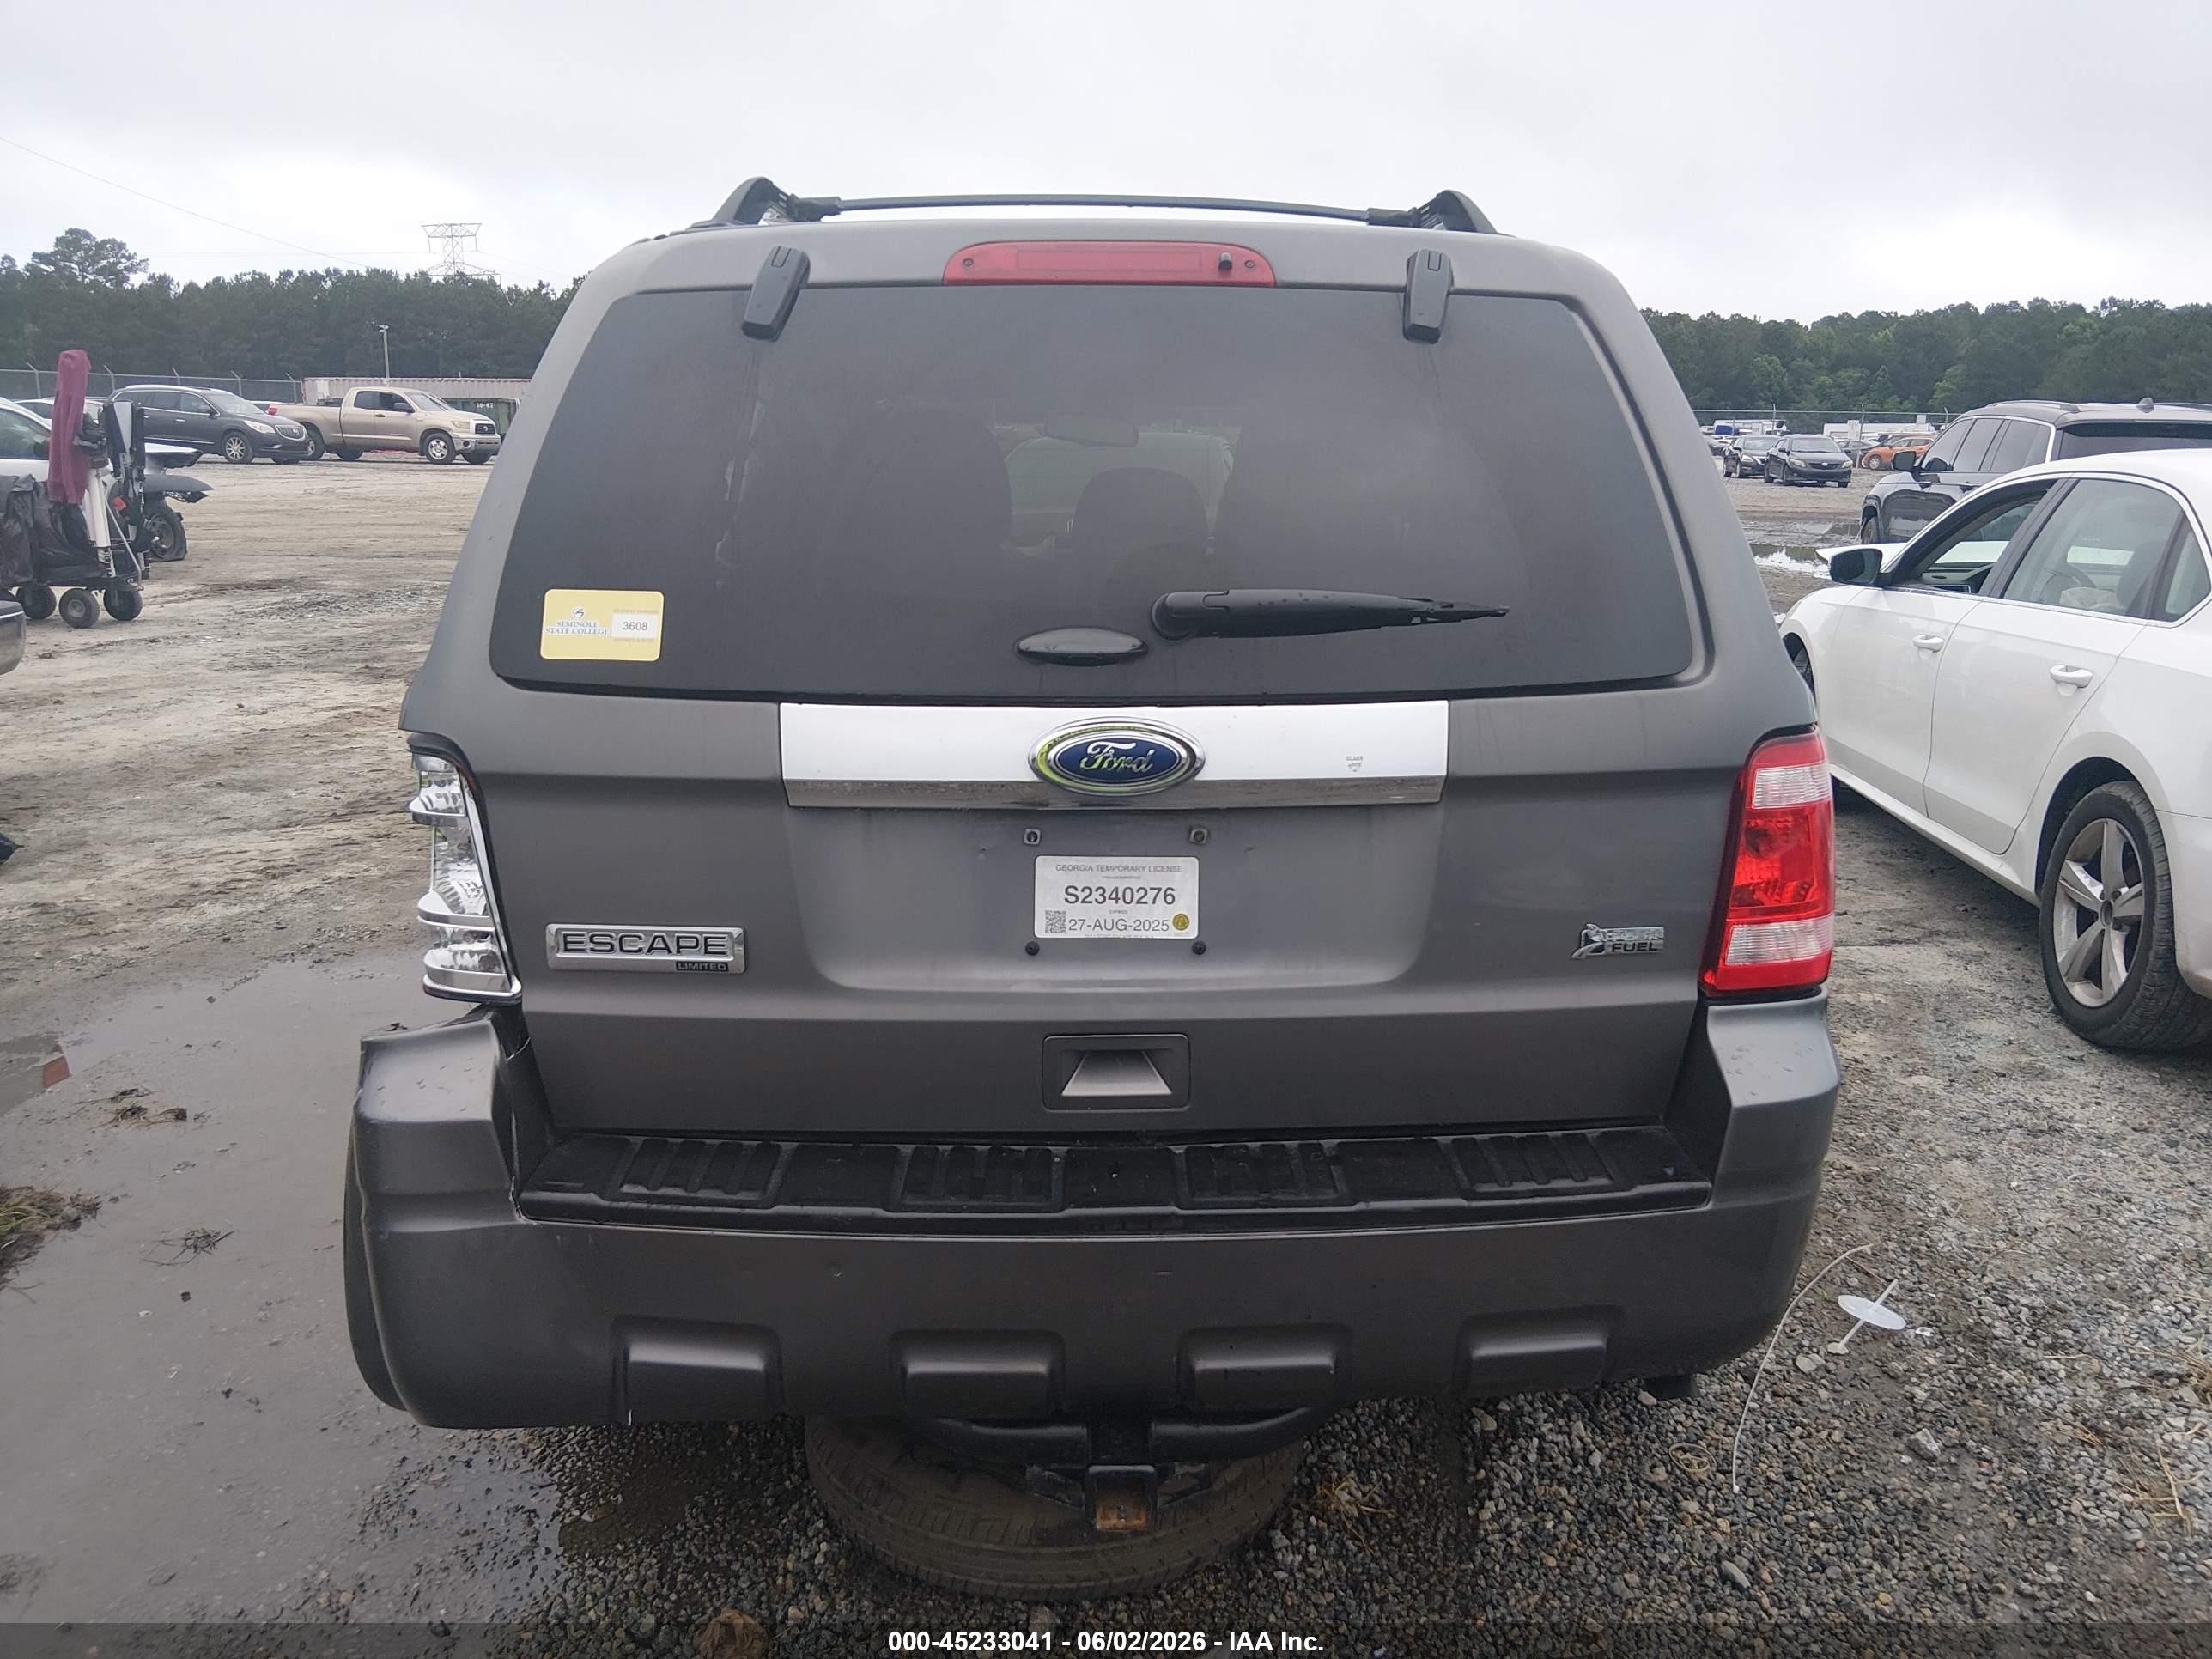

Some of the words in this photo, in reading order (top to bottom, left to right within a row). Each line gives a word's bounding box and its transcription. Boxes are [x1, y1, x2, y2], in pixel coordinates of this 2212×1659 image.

[622, 621, 648, 631] 3608
[1079, 741, 1158, 772] Ford
[1055, 864, 1093, 872] GEORGIA
[1096, 865, 1147, 873] TEMPORARY
[1064, 885, 1176, 905] S2340276
[1068, 918, 1170, 932] 27-AUG-2025
[562, 930, 731, 956] ESCAPE
[1611, 941, 1657, 952] FUEL
[677, 962, 727, 971] LIMITED
